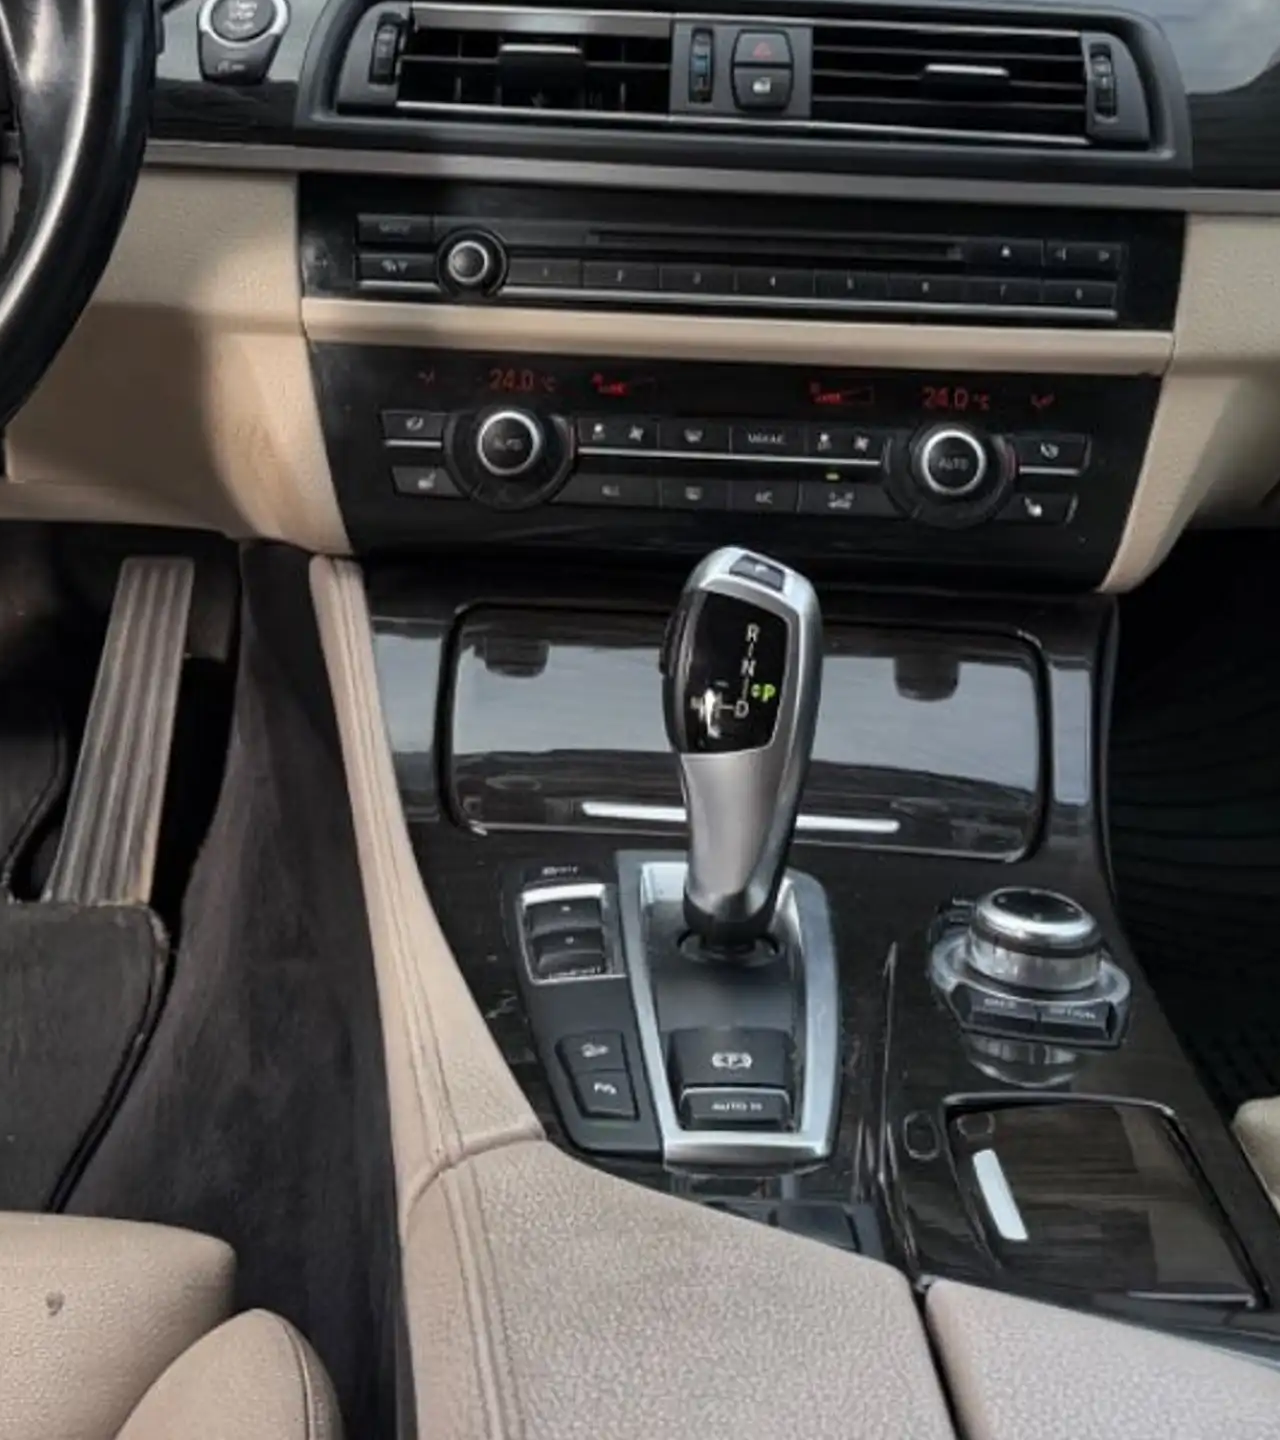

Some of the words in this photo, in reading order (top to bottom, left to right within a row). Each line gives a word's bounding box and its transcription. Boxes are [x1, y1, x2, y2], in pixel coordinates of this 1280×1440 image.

[488, 368, 535, 392] 24.0
[922, 386, 968, 409] 24.0
[746, 622, 760, 643] R
[740, 659, 757, 677] N
[763, 683, 776, 703] P
[734, 699, 750, 718] D
[710, 1102, 748, 1113] AUTO
